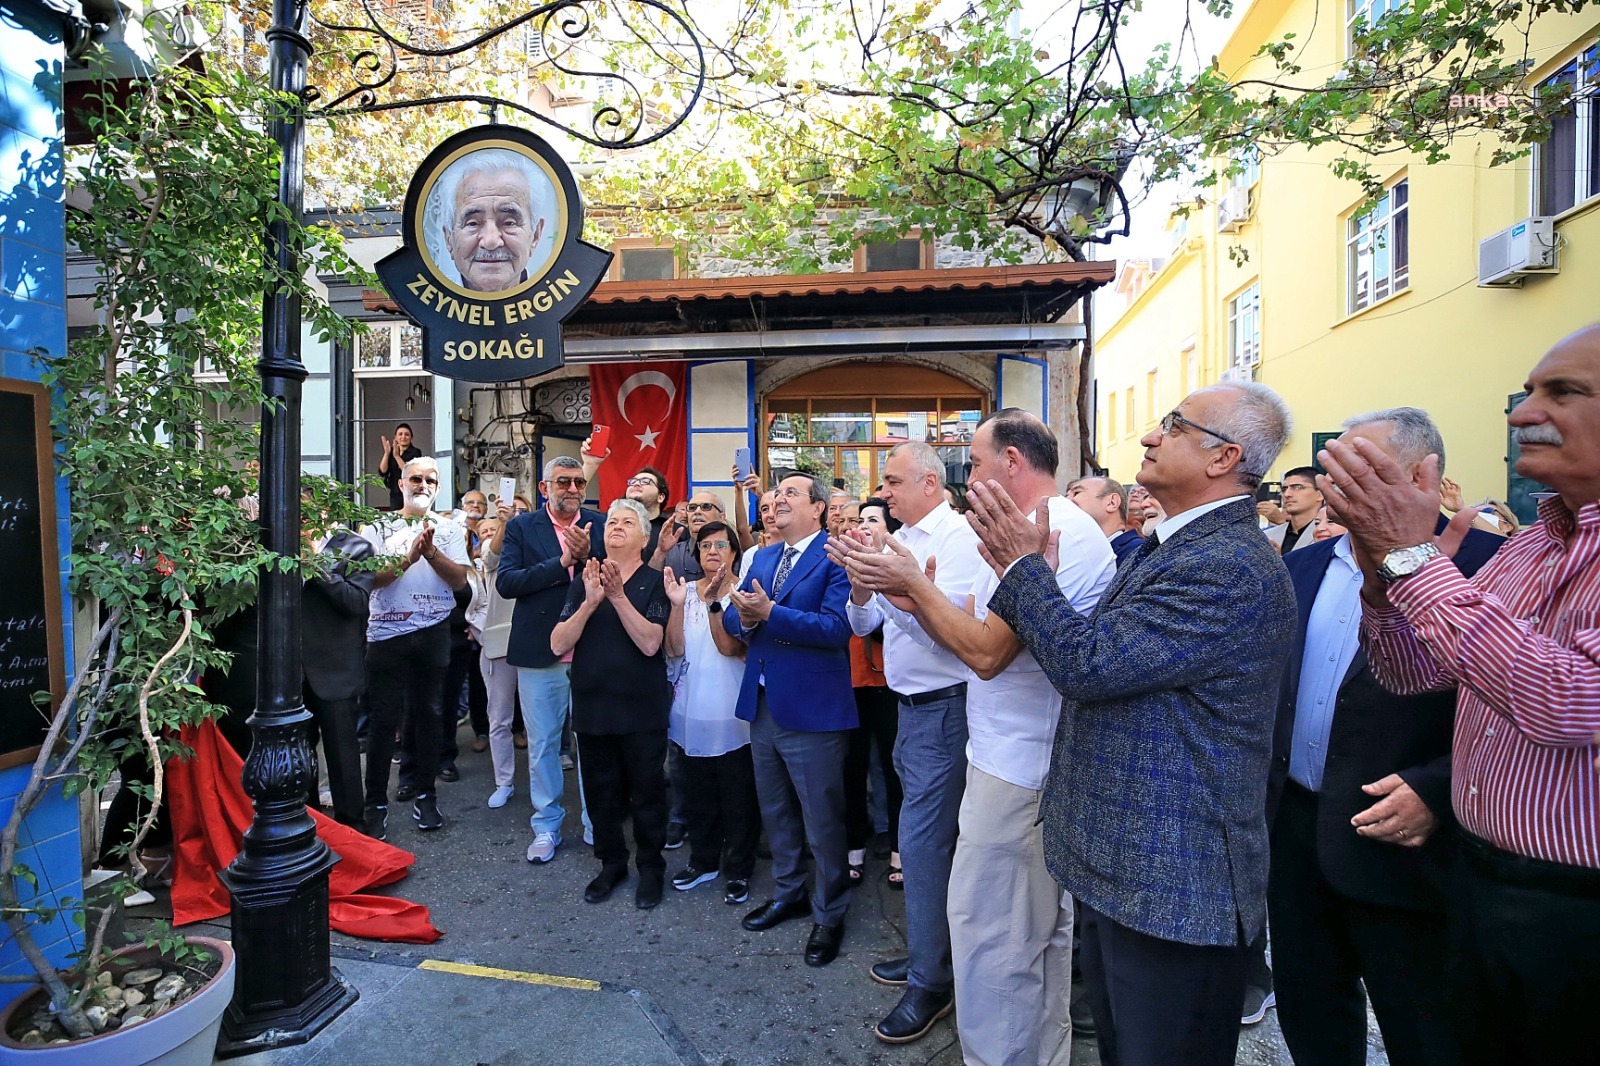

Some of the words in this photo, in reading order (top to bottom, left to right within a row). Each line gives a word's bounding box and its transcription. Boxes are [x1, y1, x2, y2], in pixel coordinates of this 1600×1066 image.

[406, 273, 495, 326] ZEYNEL
[503, 268, 581, 324] ERGİN
[443, 332, 544, 361] SOKAĞI
